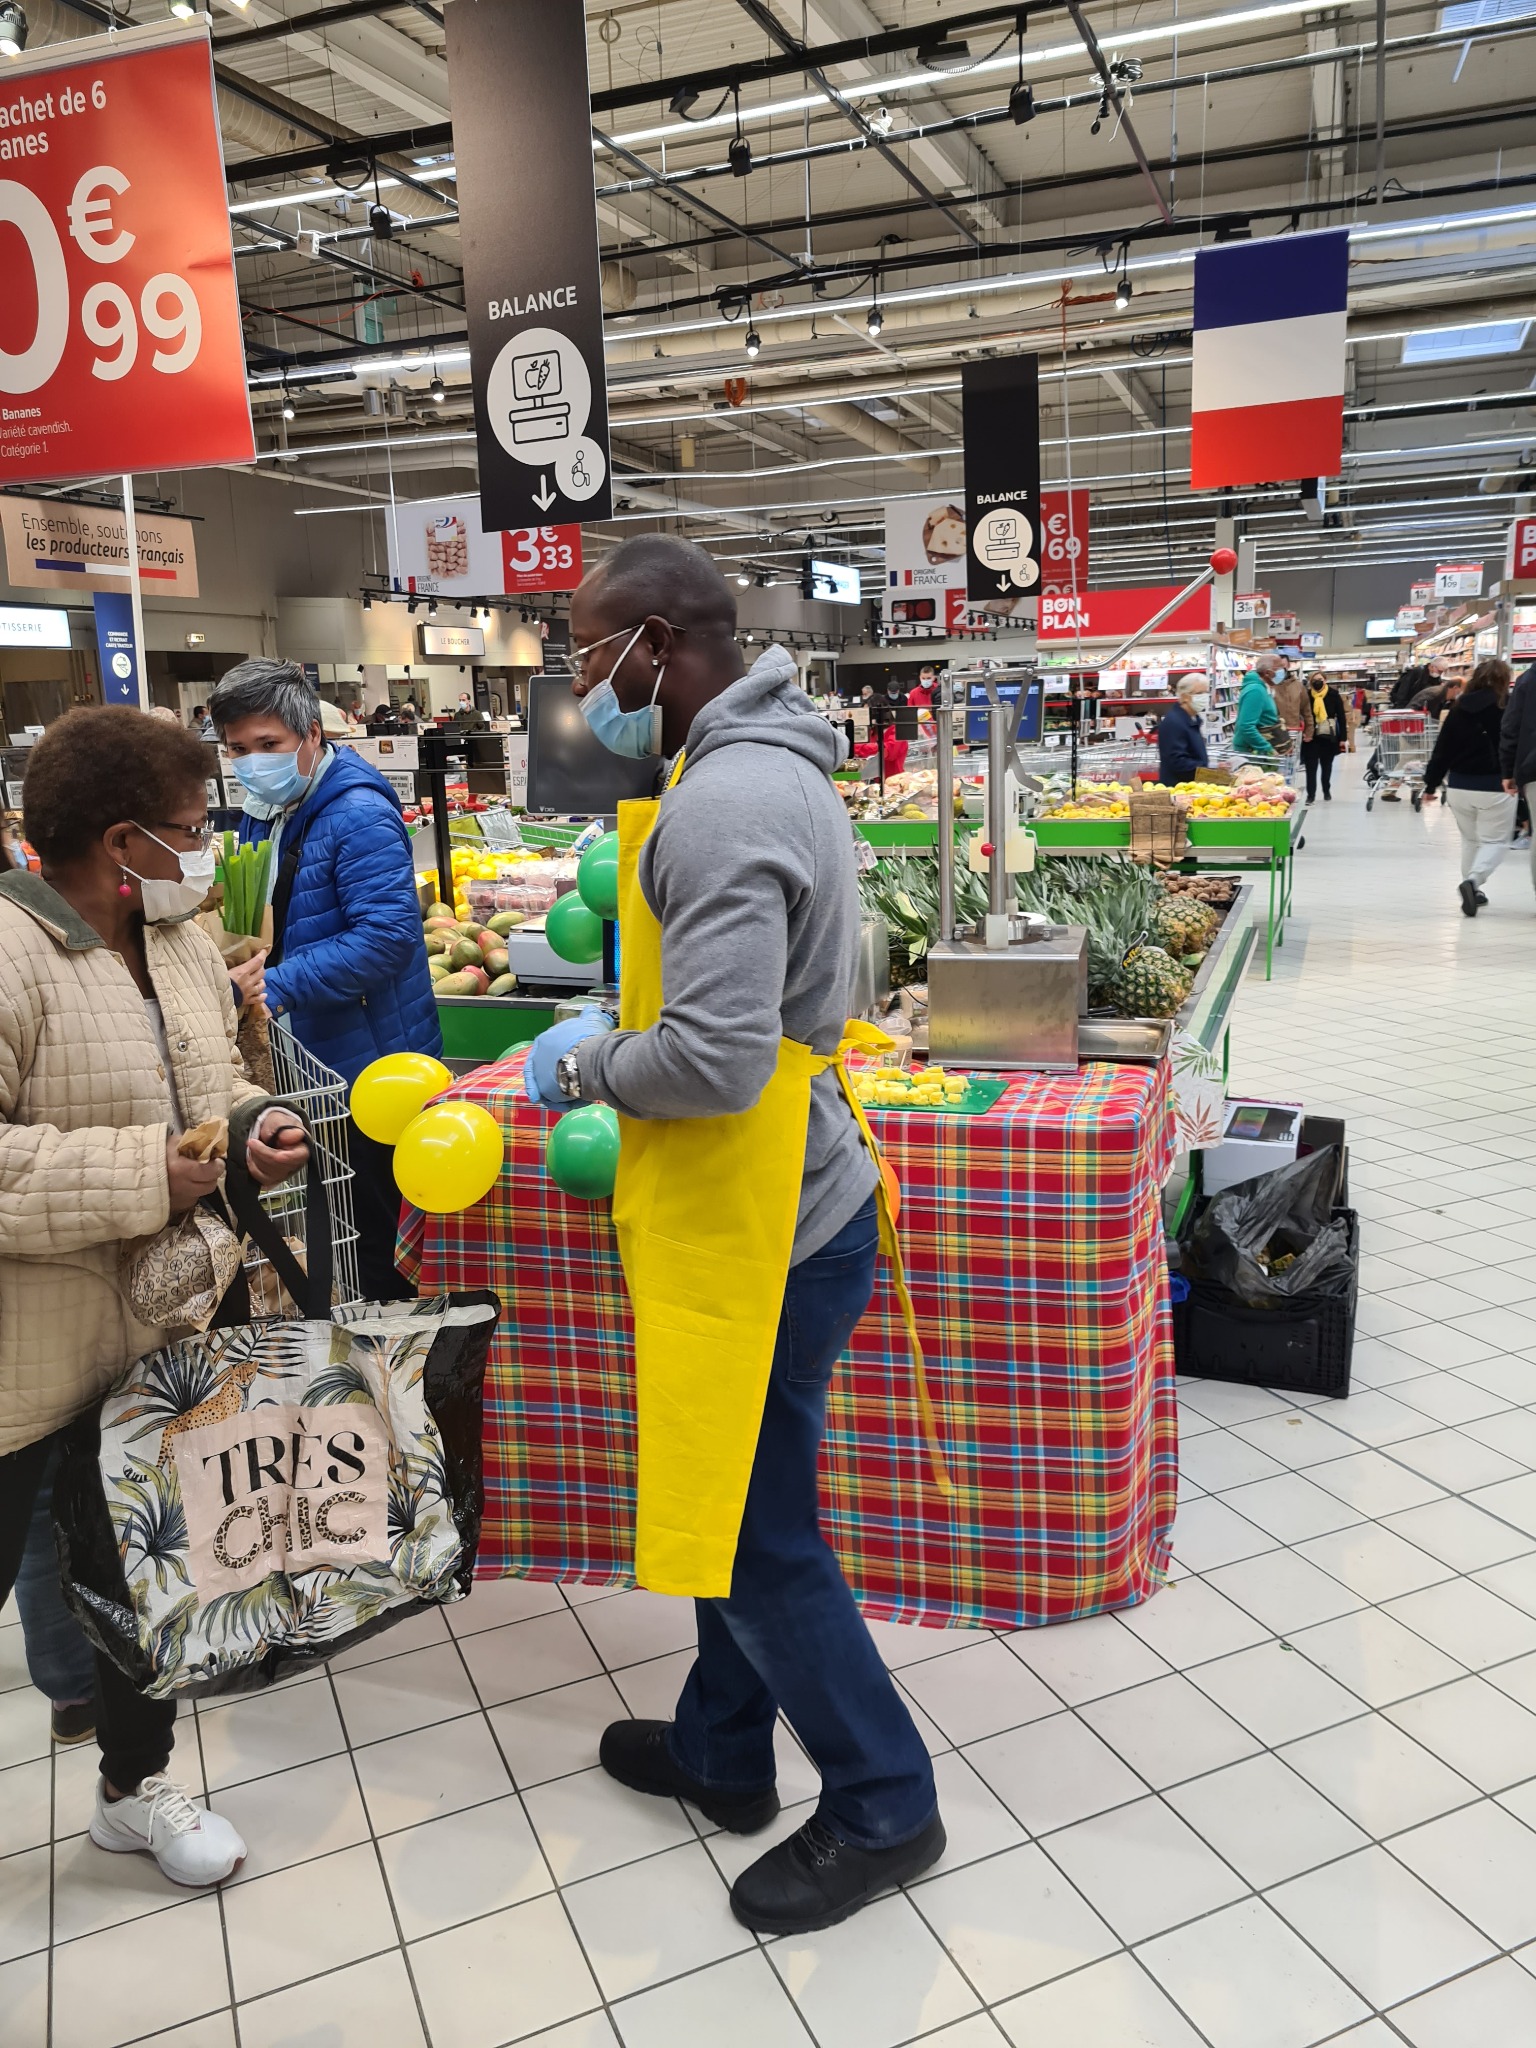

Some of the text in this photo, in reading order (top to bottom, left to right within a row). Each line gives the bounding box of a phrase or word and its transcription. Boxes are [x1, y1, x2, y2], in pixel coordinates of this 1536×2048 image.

[60, 86, 86, 116] de
[92, 80, 107, 110] 6
[67, 166, 136, 264] €
[488, 285, 578, 321] BALANCE
[81, 272, 203, 381] 99
[2, 407, 42, 420] Bananes
[28, 420, 73, 436] cavendish.
[977, 490, 1028, 504] BALANCE
[21, 513, 95, 540] Ensemble,
[26, 532, 46, 551] les
[50, 539, 129, 560] producteurs
[1048, 536, 1082, 560] 69
[542, 545, 573, 570] 33
[913, 568, 936, 576] ORIGINE
[913, 574, 948, 586] FRANCE
[417, 581, 440, 593] FRANCE
[1042, 597, 1081, 614] BON
[0, 622, 42, 632] TISSERIE
[1042, 613, 1089, 630] PLAN
[448, 638, 470, 646] BOUCHER
[203, 1416, 367, 1509] TRÈS
[212, 1490, 368, 1570] CHIC
